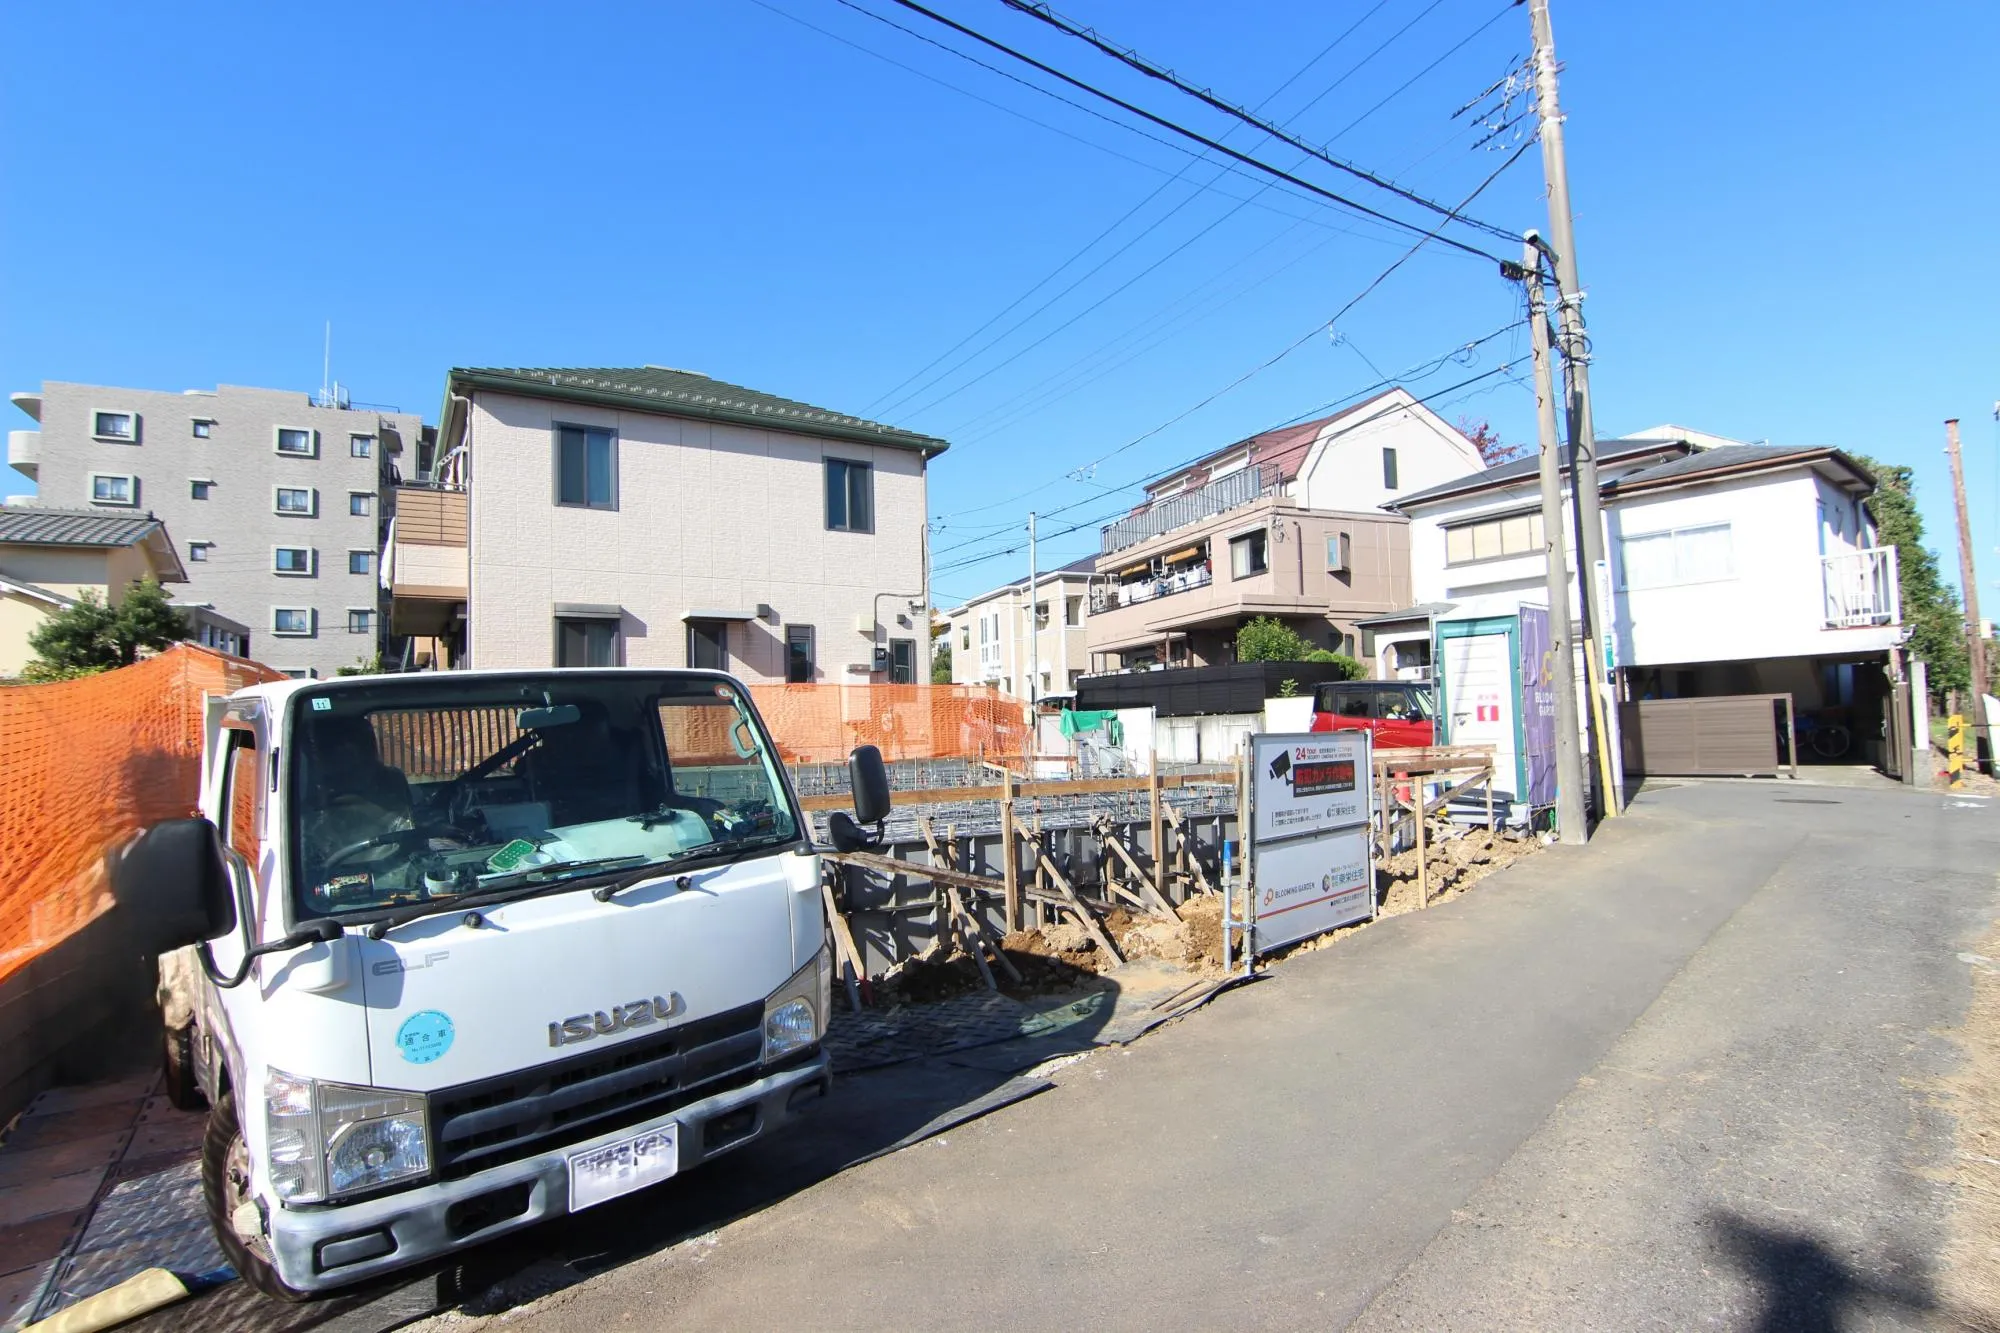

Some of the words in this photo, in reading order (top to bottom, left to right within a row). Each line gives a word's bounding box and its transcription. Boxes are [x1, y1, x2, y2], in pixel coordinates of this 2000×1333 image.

[1296, 747, 1306, 760] 24
[1275, 886, 1298, 899] BLOOMING
[1298, 882, 1315, 893] GARDEN
[372, 951, 449, 976] ELF
[549, 990, 687, 1047] ISUZU
